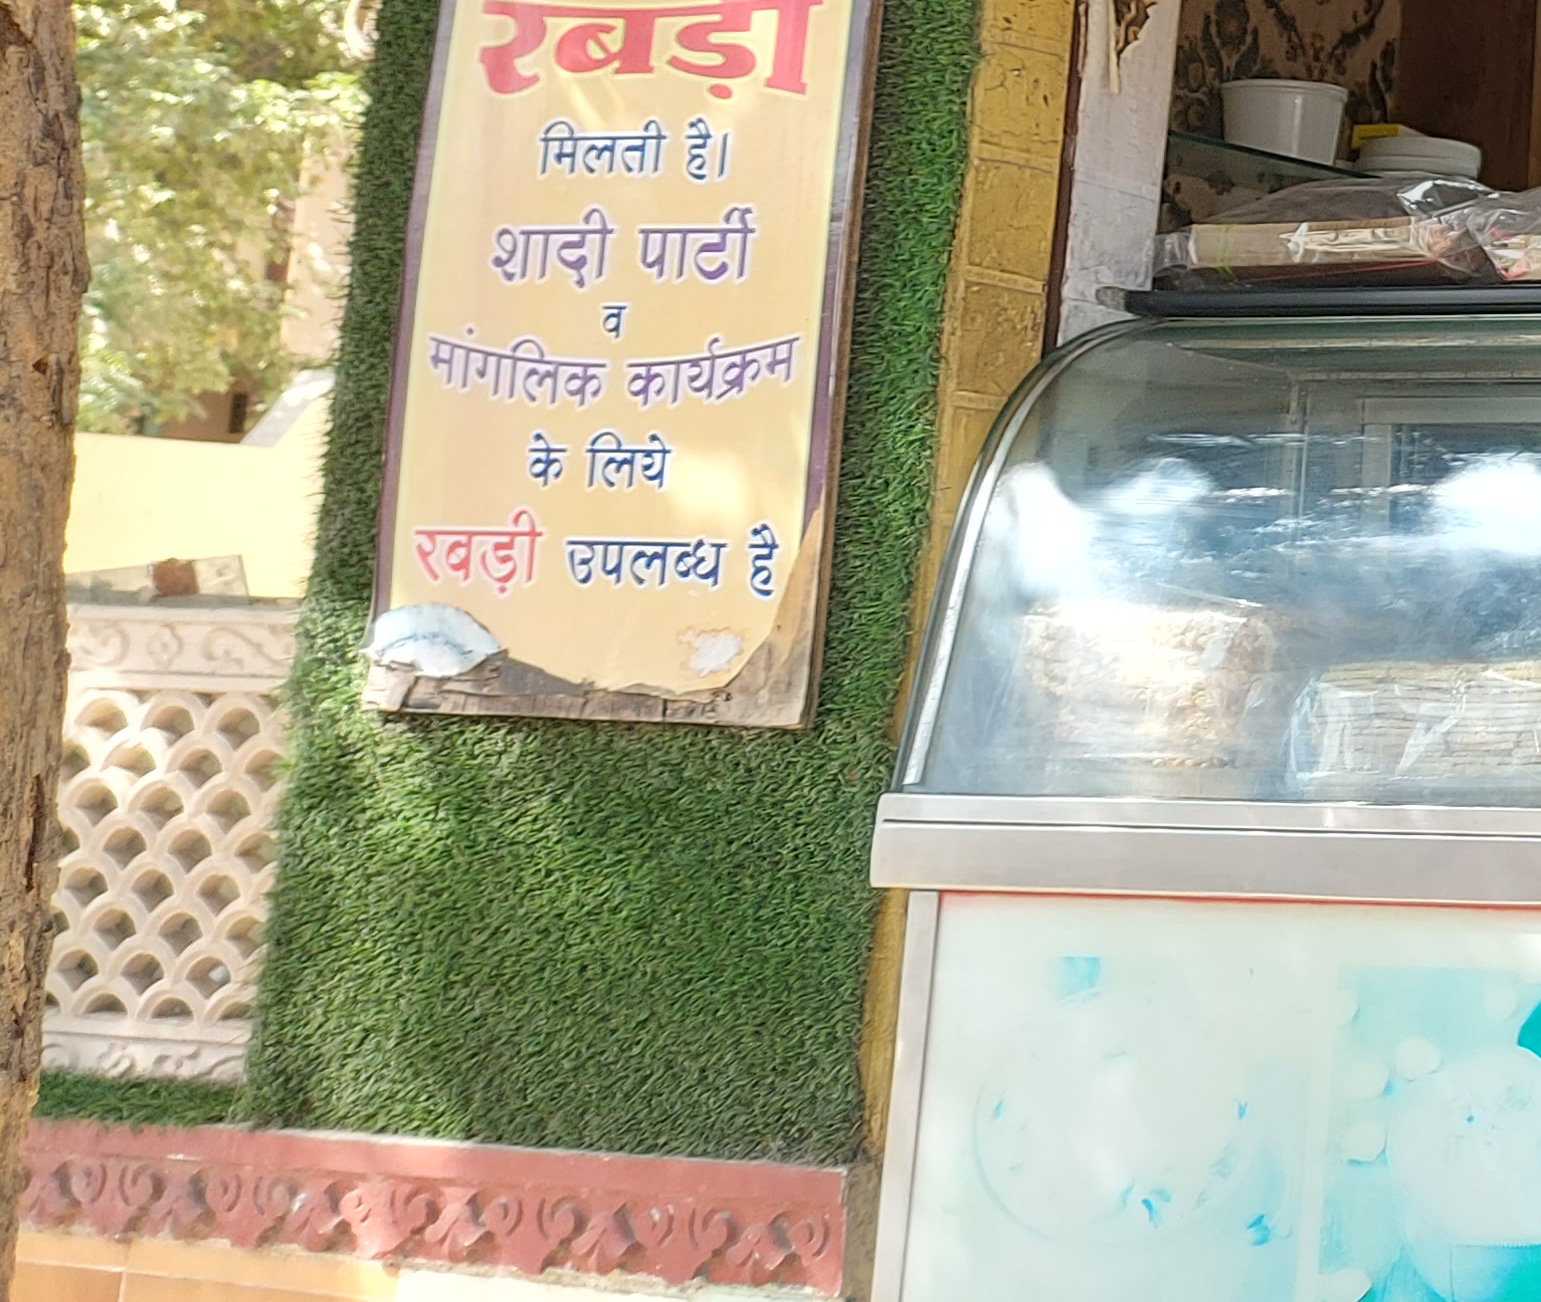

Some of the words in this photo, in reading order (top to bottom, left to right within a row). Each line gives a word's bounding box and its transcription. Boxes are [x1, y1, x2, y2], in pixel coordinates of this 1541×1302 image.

[539, 120, 668, 176] मिलती
[492, 208, 613, 288] शादी
[639, 207, 755, 282] पार्टी
[602, 304, 627, 338] व
[429, 325, 608, 406] मांगलिक
[627, 335, 800, 406] कार्यक्रम
[528, 432, 567, 487] के
[586, 431, 672, 489] लिये
[414, 509, 543, 592] रबड़ी
[566, 538, 727, 588] उपलब्ध
[748, 523, 780, 596] है
